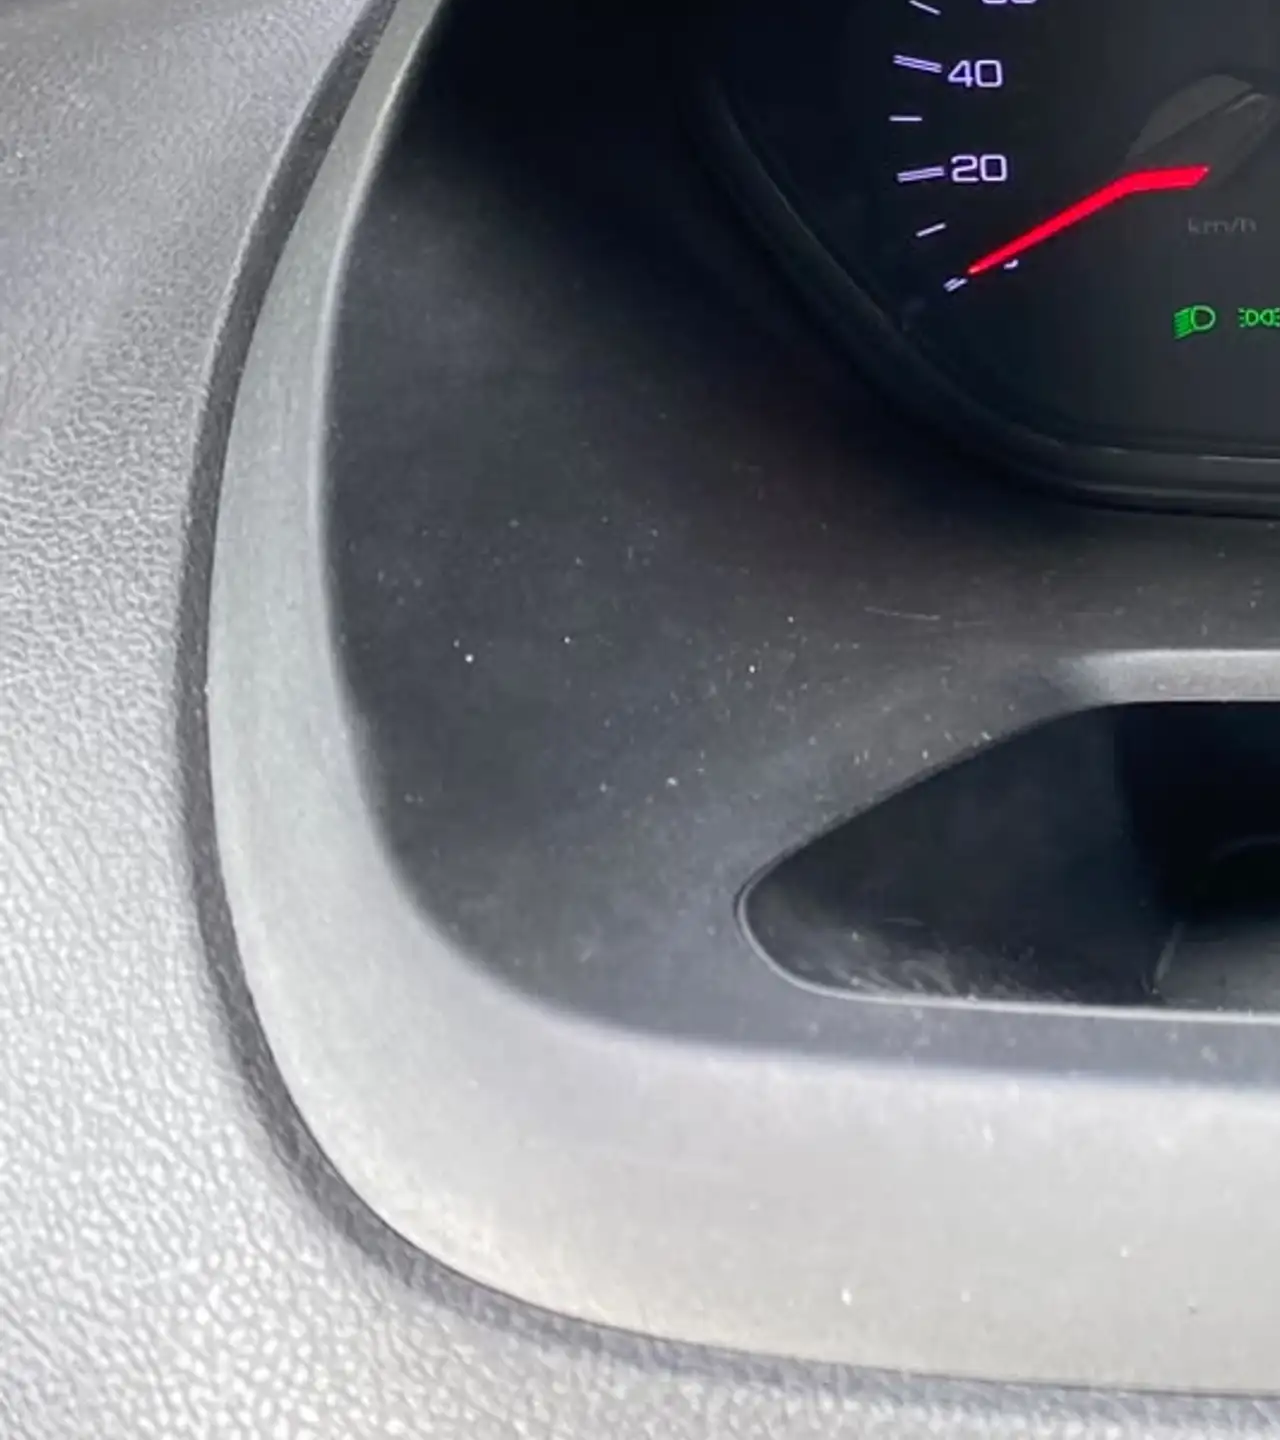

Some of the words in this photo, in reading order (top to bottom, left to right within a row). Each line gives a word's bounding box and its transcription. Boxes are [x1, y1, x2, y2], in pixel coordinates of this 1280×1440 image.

[947, 59, 1003, 88] 40
[951, 154, 1008, 183] 20
[1187, 216, 1258, 235] km/h
